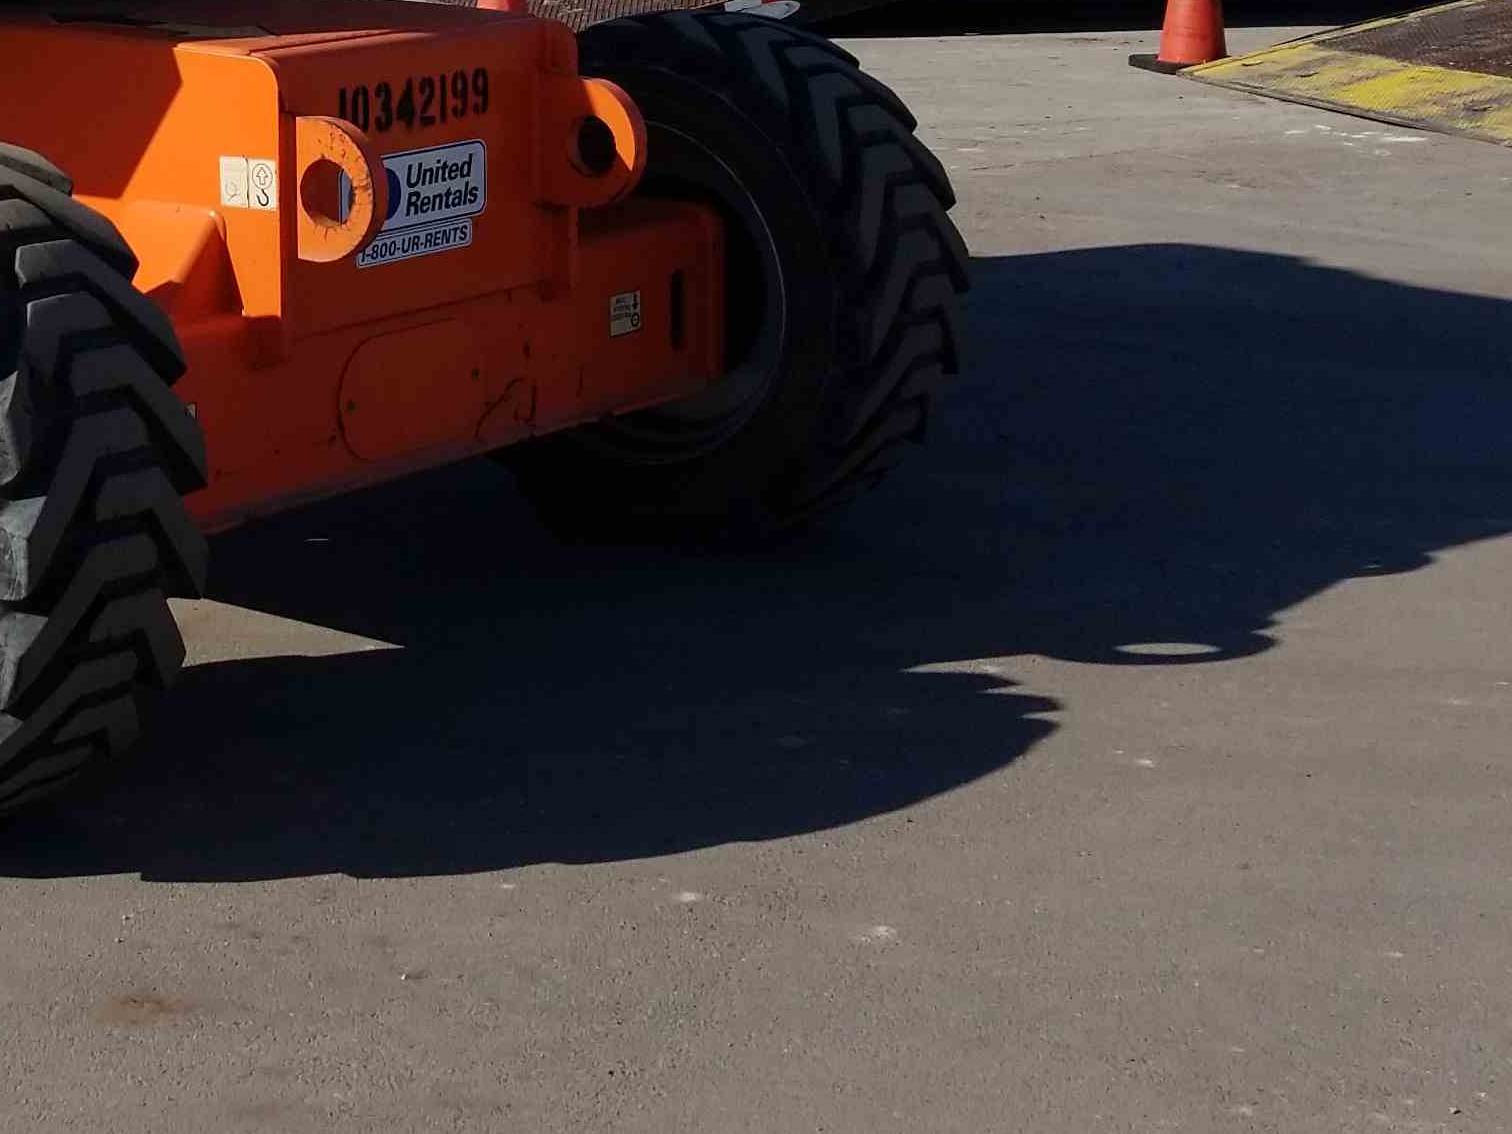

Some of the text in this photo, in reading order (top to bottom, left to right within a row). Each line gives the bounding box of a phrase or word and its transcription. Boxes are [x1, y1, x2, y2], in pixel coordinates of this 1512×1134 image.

[338, 67, 489, 134] 10342199
[405, 153, 473, 189] United
[405, 183, 479, 217] Rentals
[360, 223, 469, 263] 1-800-UR-RENTS
